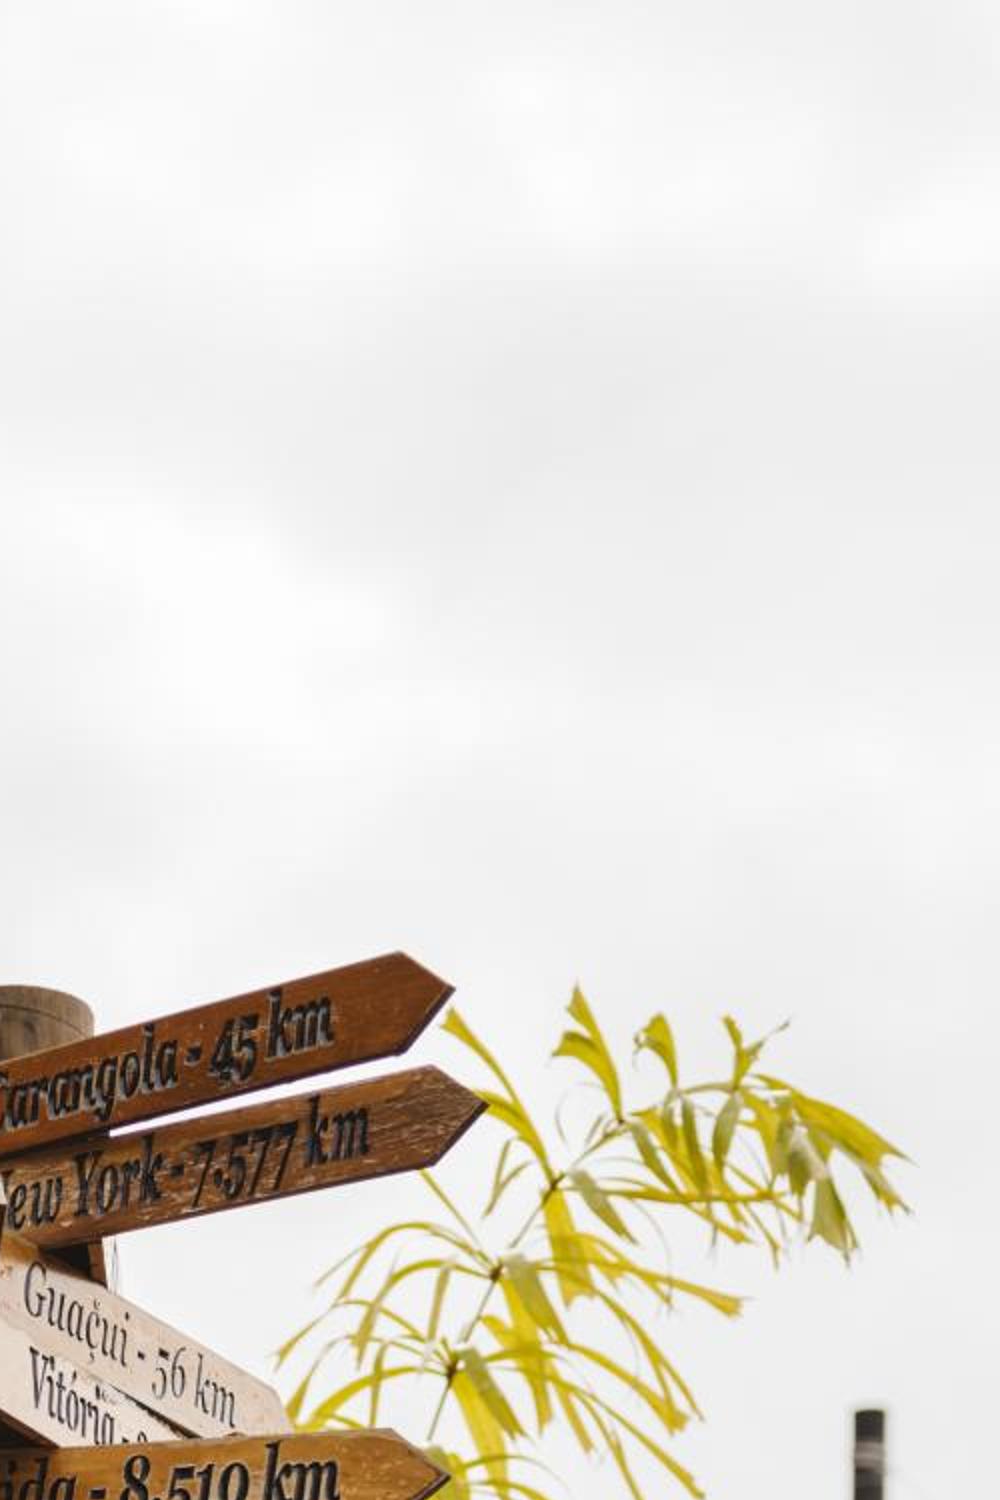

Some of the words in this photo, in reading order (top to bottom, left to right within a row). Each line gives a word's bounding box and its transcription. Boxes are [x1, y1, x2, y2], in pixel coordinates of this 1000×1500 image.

[209, 1013, 258, 1083] 45
[268, 988, 334, 1059] km
[3, 1167, 63, 1229] ew
[73, 1134, 162, 1217] York
[190, 1120, 299, 1208] 7.577
[306, 1094, 369, 1167] km
[151, 1346, 187, 1400] 56
[194, 1352, 236, 1429] km
